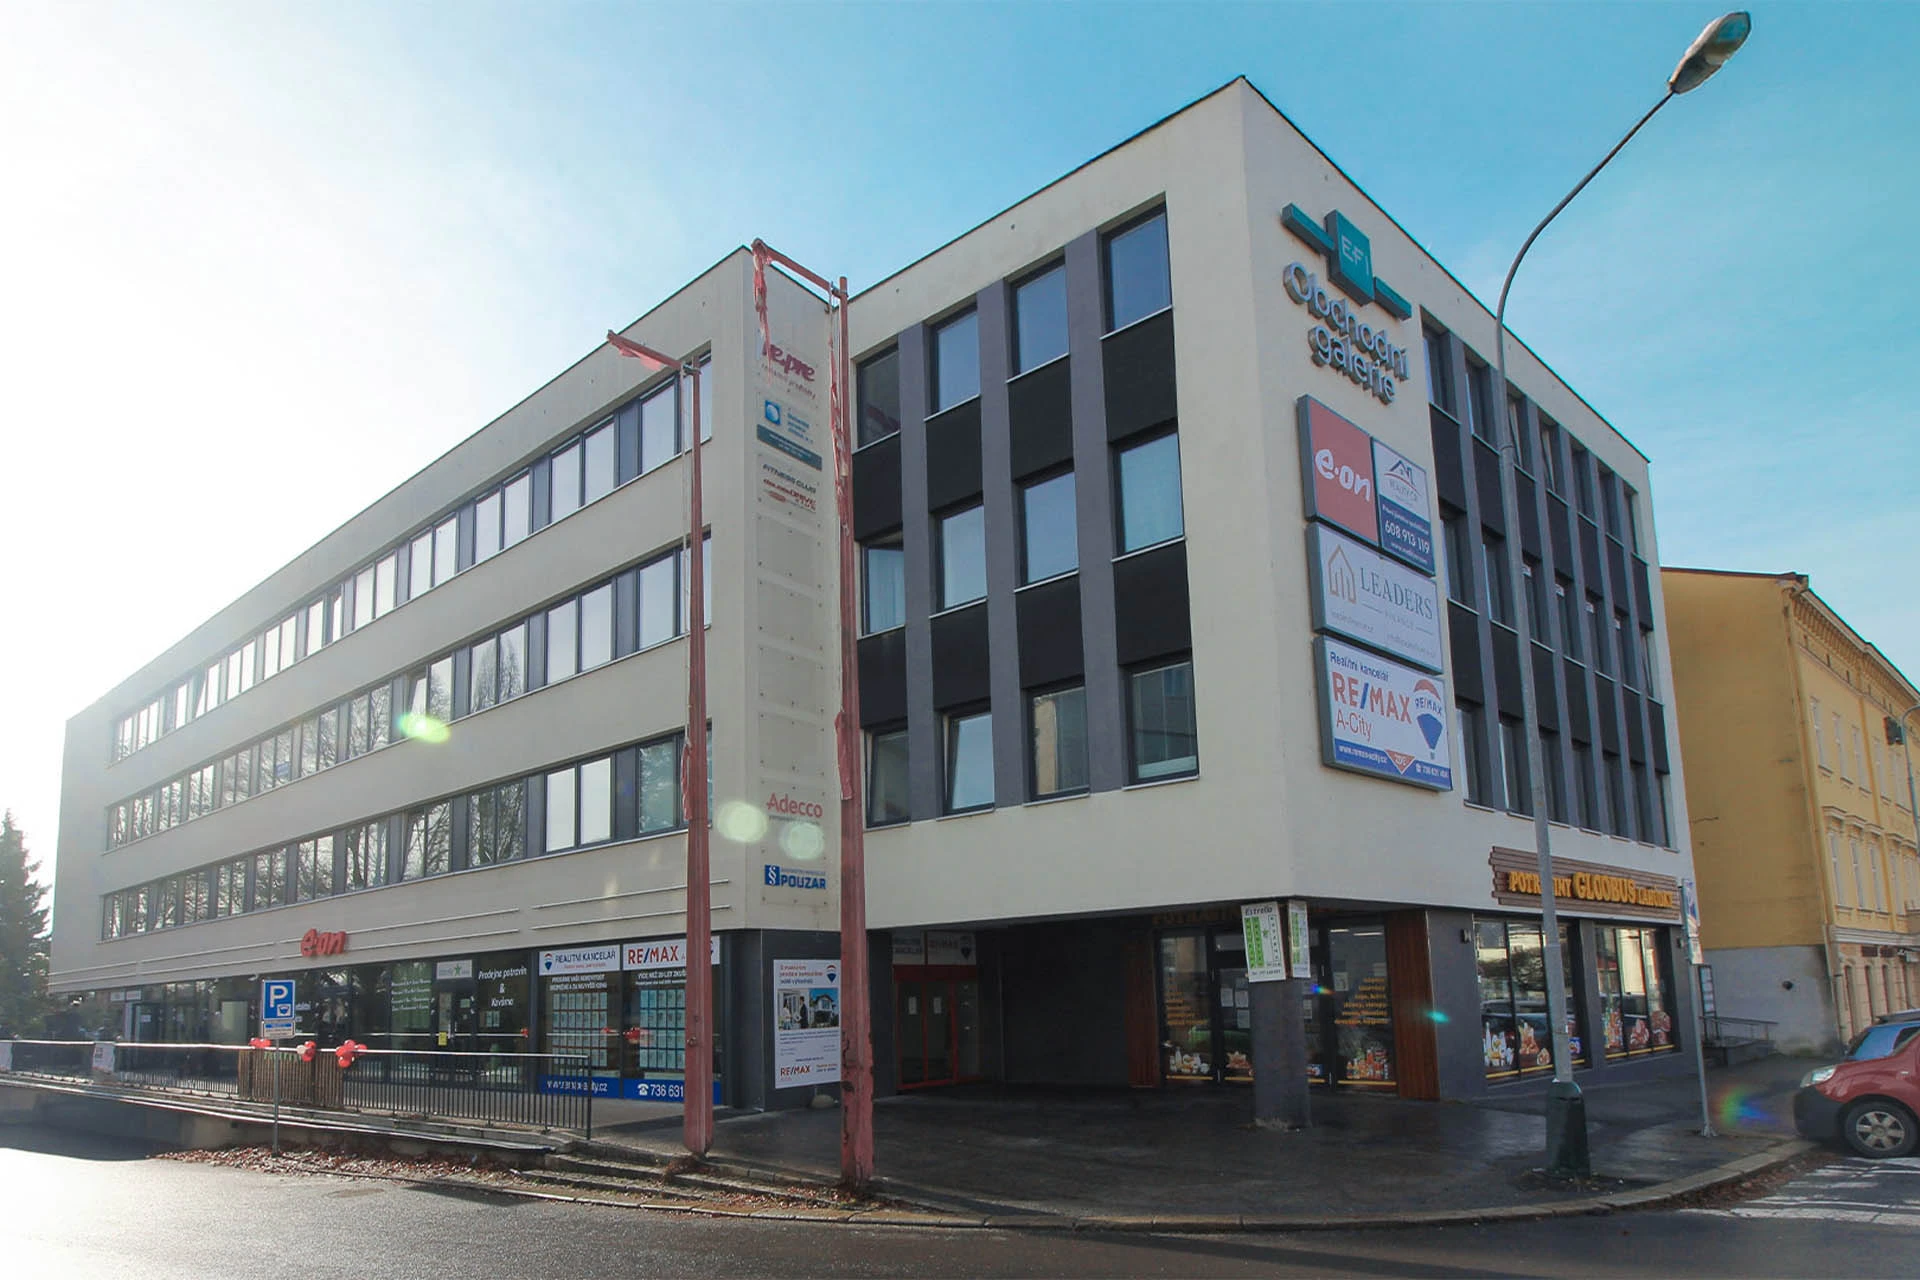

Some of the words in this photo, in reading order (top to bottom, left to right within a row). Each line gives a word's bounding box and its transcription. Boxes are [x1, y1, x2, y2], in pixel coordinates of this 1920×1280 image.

[1283, 261, 1409, 381] Obchodní
[1308, 325, 1395, 405] galerie
[1360, 566, 1433, 621] LEADERS
[1331, 671, 1413, 725] RE/MAX
[1414, 697, 1442, 716] RE/MAX
[1336, 708, 1372, 742] A-City
[766, 792, 823, 818] Adecco
[781, 874, 826, 890] POUZAR
[628, 945, 679, 964] RE/MAX
[269, 985, 288, 1008] P
[780, 1064, 811, 1077] RE/MAX
[650, 1084, 666, 1096] 736
[668, 1085, 684, 1098] 631
